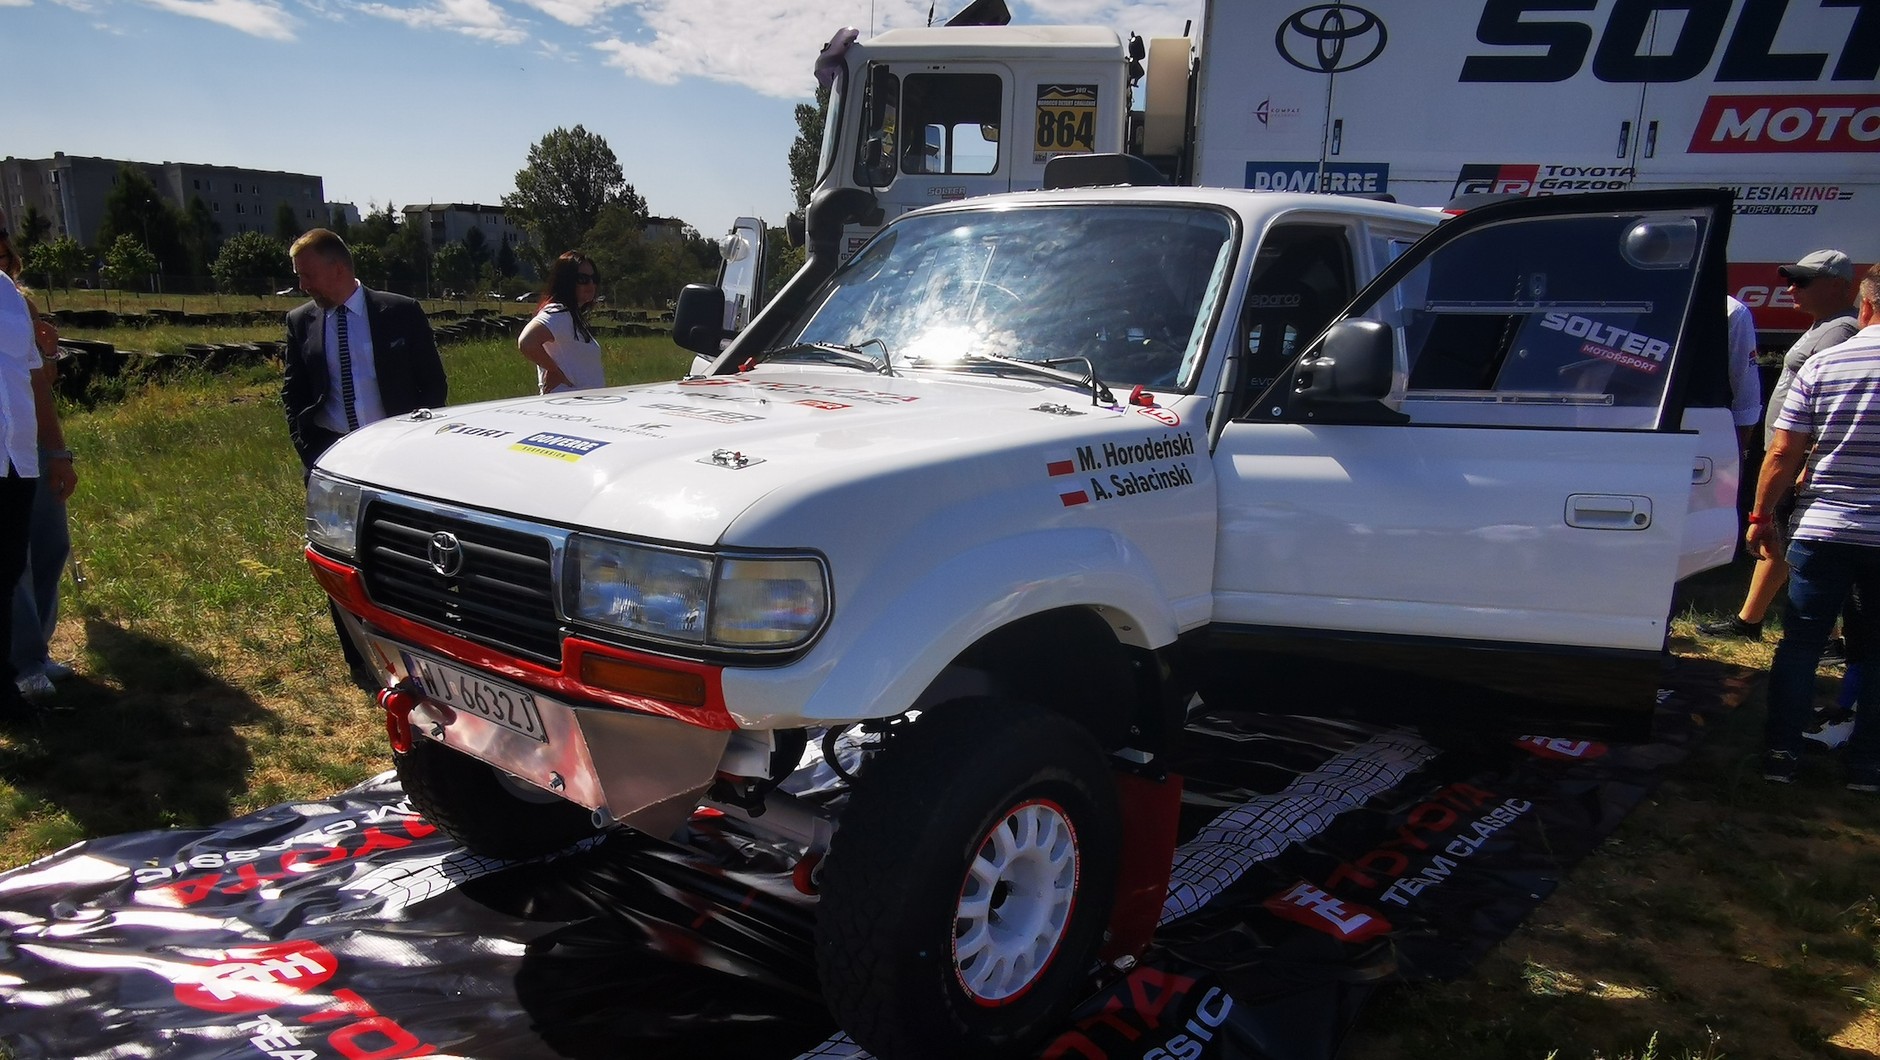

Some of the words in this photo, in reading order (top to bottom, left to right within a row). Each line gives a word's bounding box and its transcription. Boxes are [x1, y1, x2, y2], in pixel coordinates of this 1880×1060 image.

[1037, 110, 1093, 148] 864
[1545, 165, 1636, 177] TOYOTA
[927, 186, 967, 195] SOLTER
[1539, 179, 1625, 190] GAZOO
[1720, 186, 1840, 200] LESIARING
[1747, 205, 1777, 214] OPEN
[1778, 205, 1815, 214] TRACK
[1251, 294, 1300, 304] sparco
[1736, 285, 1795, 308] GE
[1540, 311, 1671, 362] SOLTER
[1583, 344, 1657, 372] MOTORSPORT
[1076, 446, 1102, 471] M.
[1103, 431, 1194, 467] Horodeński
[1090, 477, 1113, 500] A.
[416, 660, 452, 701] WJ
[460, 676, 534, 733] 6632J
[1326, 783, 1498, 890] TOYOTA
[1379, 854, 1458, 906] TEAM
[1445, 798, 1534, 858] CLASSIC
[298, 988, 437, 1060] TO
